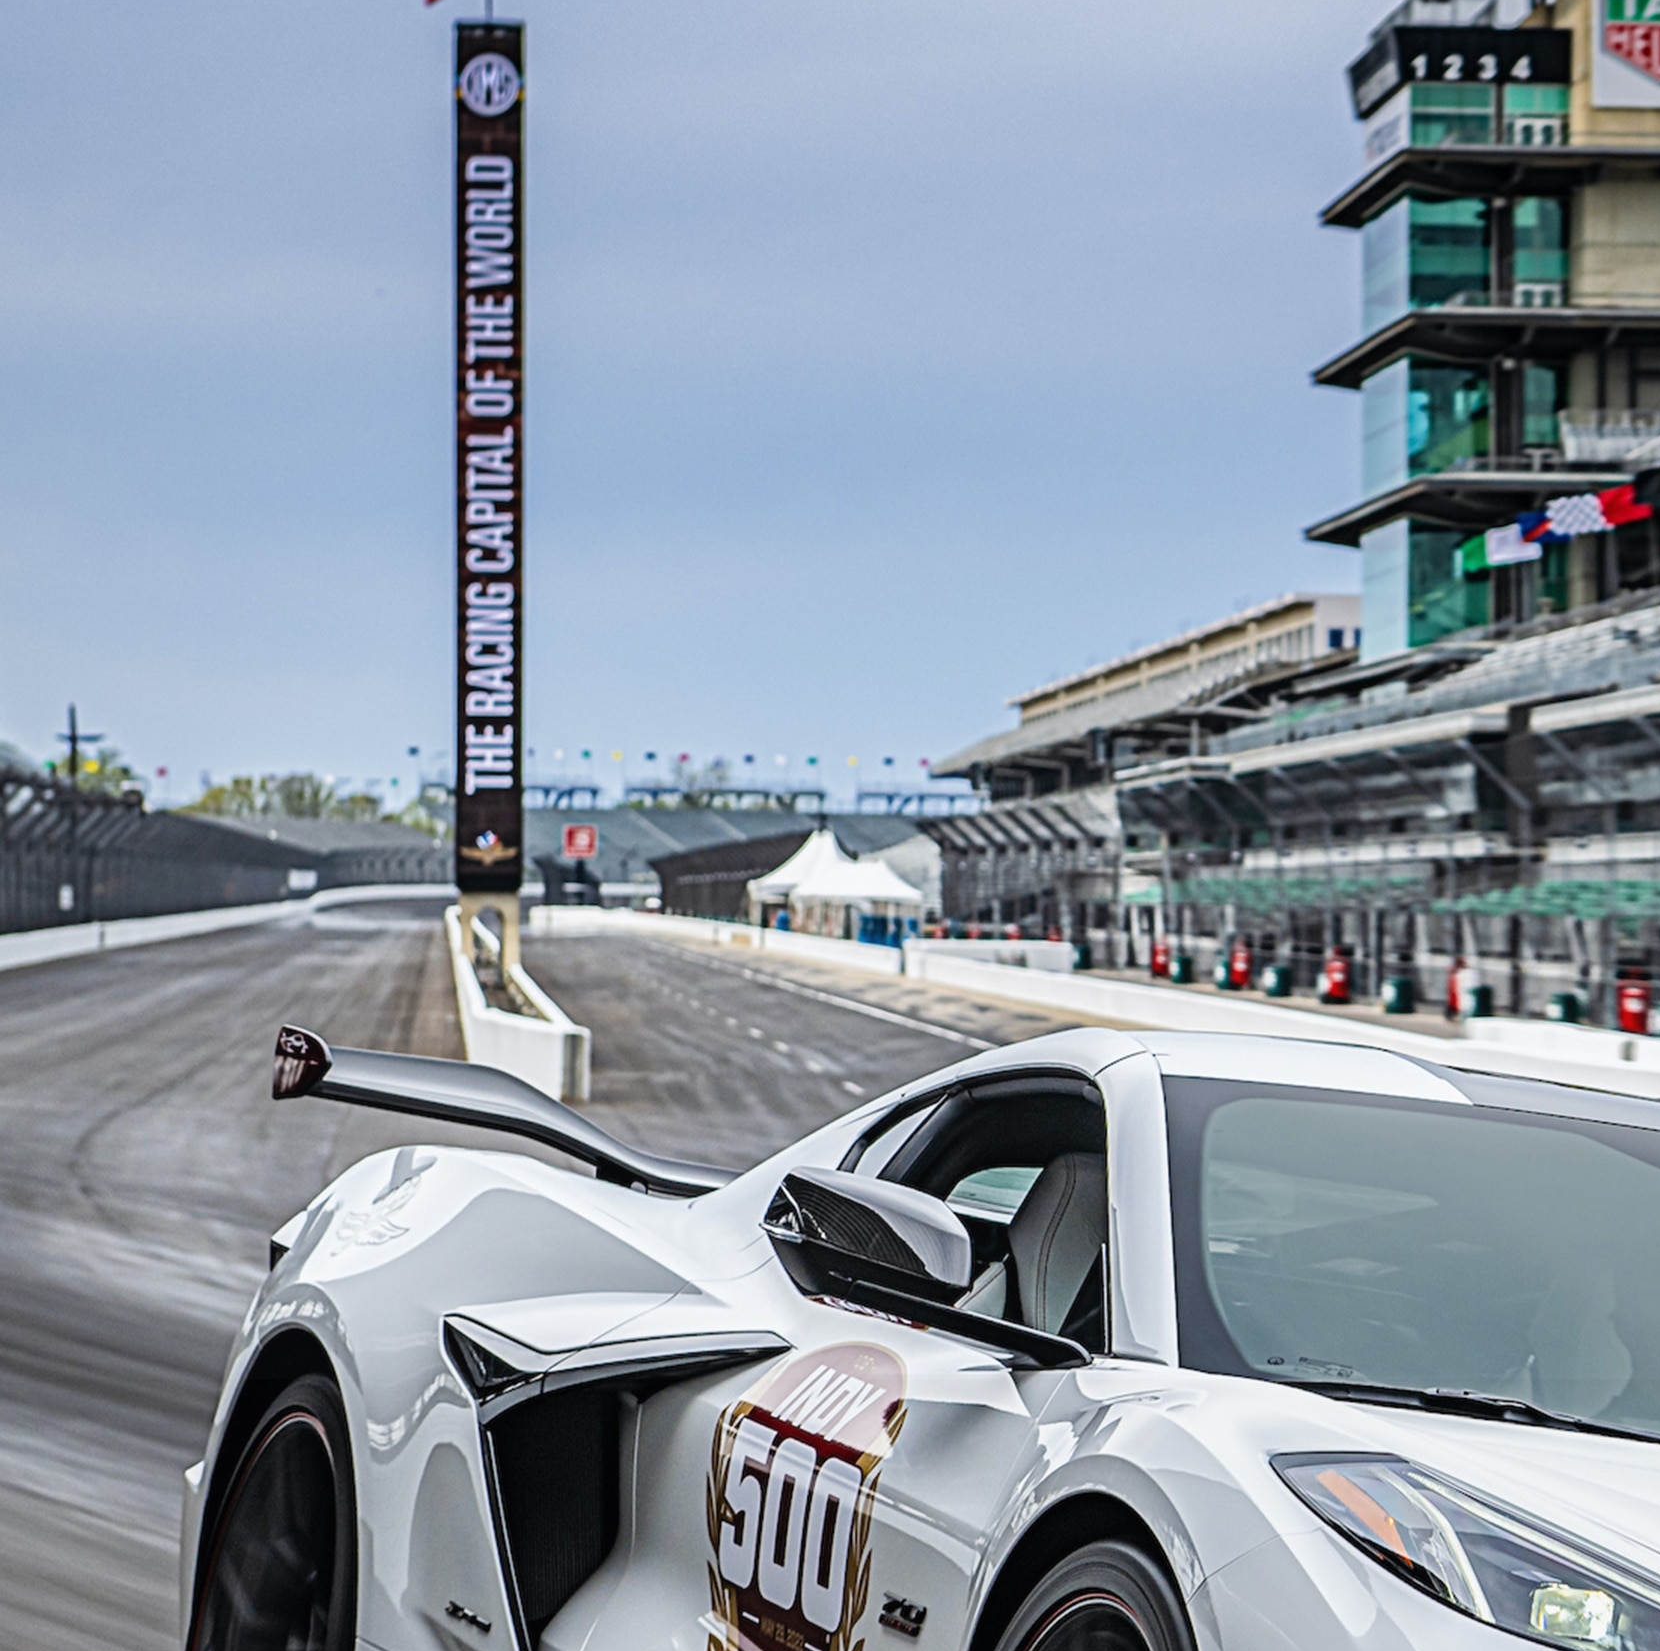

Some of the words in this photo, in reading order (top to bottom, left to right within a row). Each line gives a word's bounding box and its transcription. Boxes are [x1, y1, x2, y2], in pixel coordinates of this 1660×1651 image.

[1410, 53, 1428, 80] 1
[1442, 53, 1465, 81] 2
[1477, 53, 1499, 81] 3
[1510, 53, 1532, 81] 4
[464, 155, 514, 288] WORLD
[464, 295, 514, 364] THE
[464, 369, 514, 416] OF
[464, 425, 514, 573] CAPITAL
[464, 582, 514, 716] RACING
[464, 724, 514, 795] THE
[770, 1364, 886, 1441] INDY
[719, 1417, 862, 1633] 500
